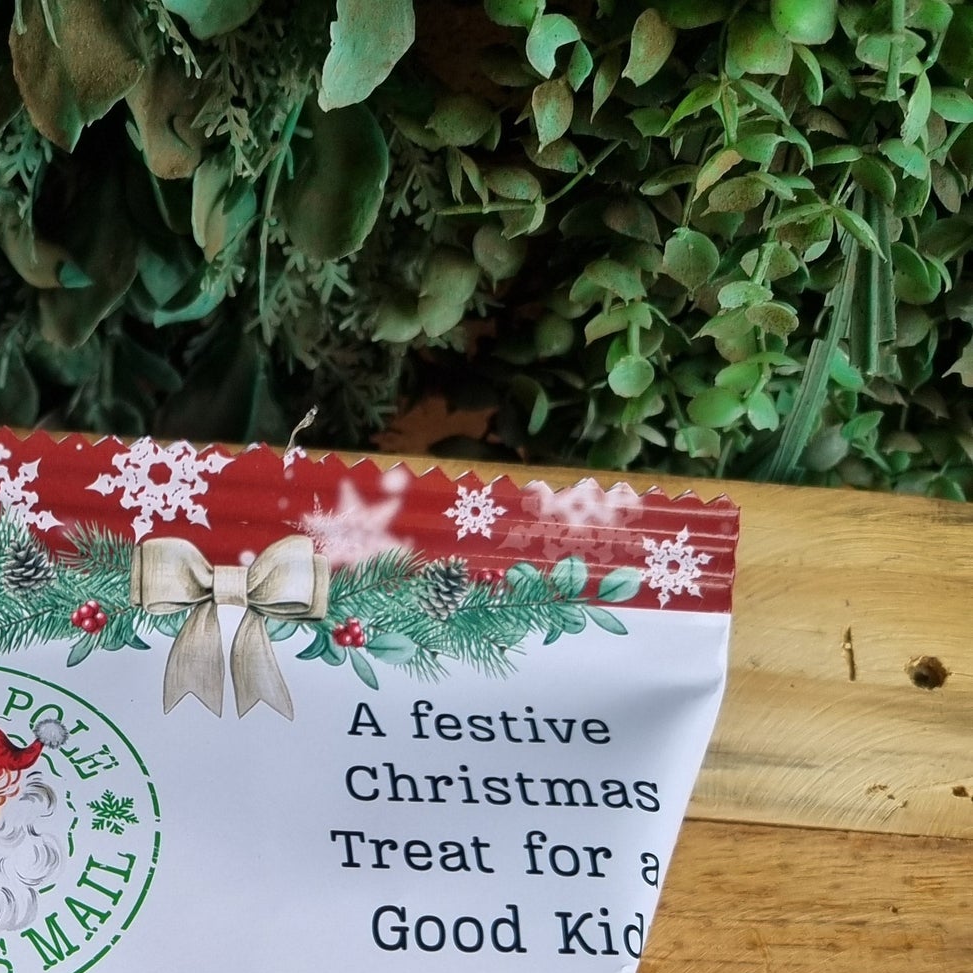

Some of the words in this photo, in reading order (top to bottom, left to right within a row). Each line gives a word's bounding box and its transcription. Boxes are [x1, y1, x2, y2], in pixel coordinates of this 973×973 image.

[3, 686, 120, 780] POLE
[347, 702, 387, 738] A
[410, 700, 611, 744] festive
[345, 763, 660, 812] Christmas
[330, 830, 494, 873] Treat
[523, 830, 613, 878] for
[640, 852, 660, 889] a
[21, 851, 137, 971] MAIL
[371, 904, 527, 954] Good
